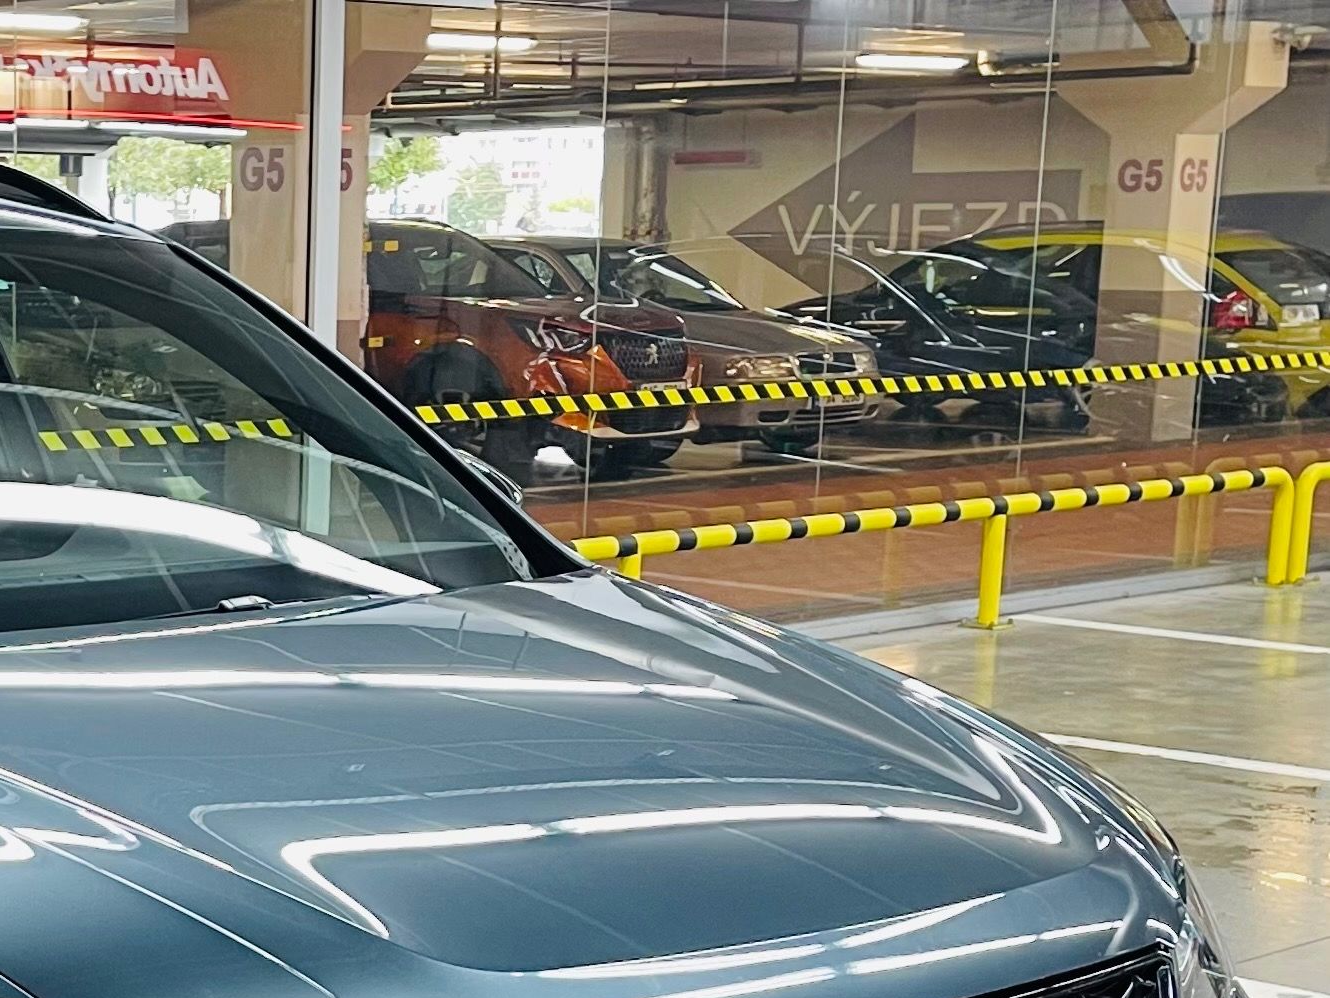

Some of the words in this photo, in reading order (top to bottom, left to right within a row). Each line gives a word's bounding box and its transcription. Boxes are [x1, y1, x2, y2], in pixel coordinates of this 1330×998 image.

[240, 147, 285, 192] G5
[1117, 158, 1163, 192] G5
[1180, 158, 1208, 192] G5
